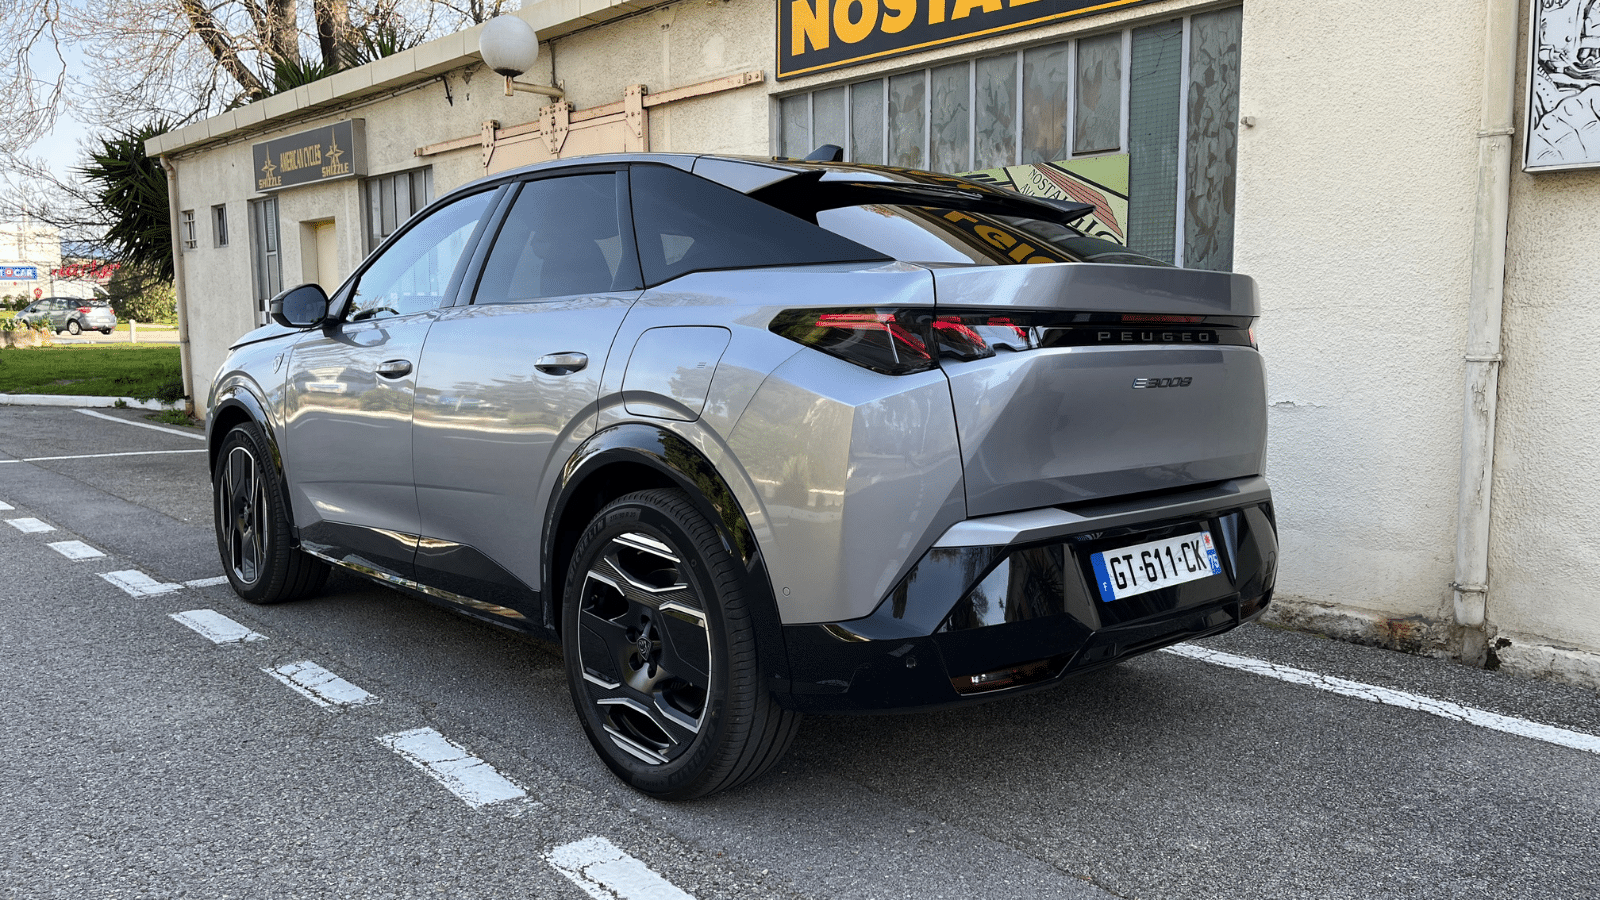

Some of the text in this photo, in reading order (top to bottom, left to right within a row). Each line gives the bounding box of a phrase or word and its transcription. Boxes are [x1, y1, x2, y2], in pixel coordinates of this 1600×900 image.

[791, 0, 1042, 56] NOS
[303, 143, 322, 168] CYCLES
[321, 162, 349, 178] SHIZZLE
[258, 175, 282, 189] SHIZZLE
[13, 268, 34, 277] CAR
[1097, 331, 1221, 342] PEUGEO
[568, 518, 605, 583] MICHELIN
[1109, 539, 1208, 590] GT-611-CK
[1102, 581, 1108, 592] F
